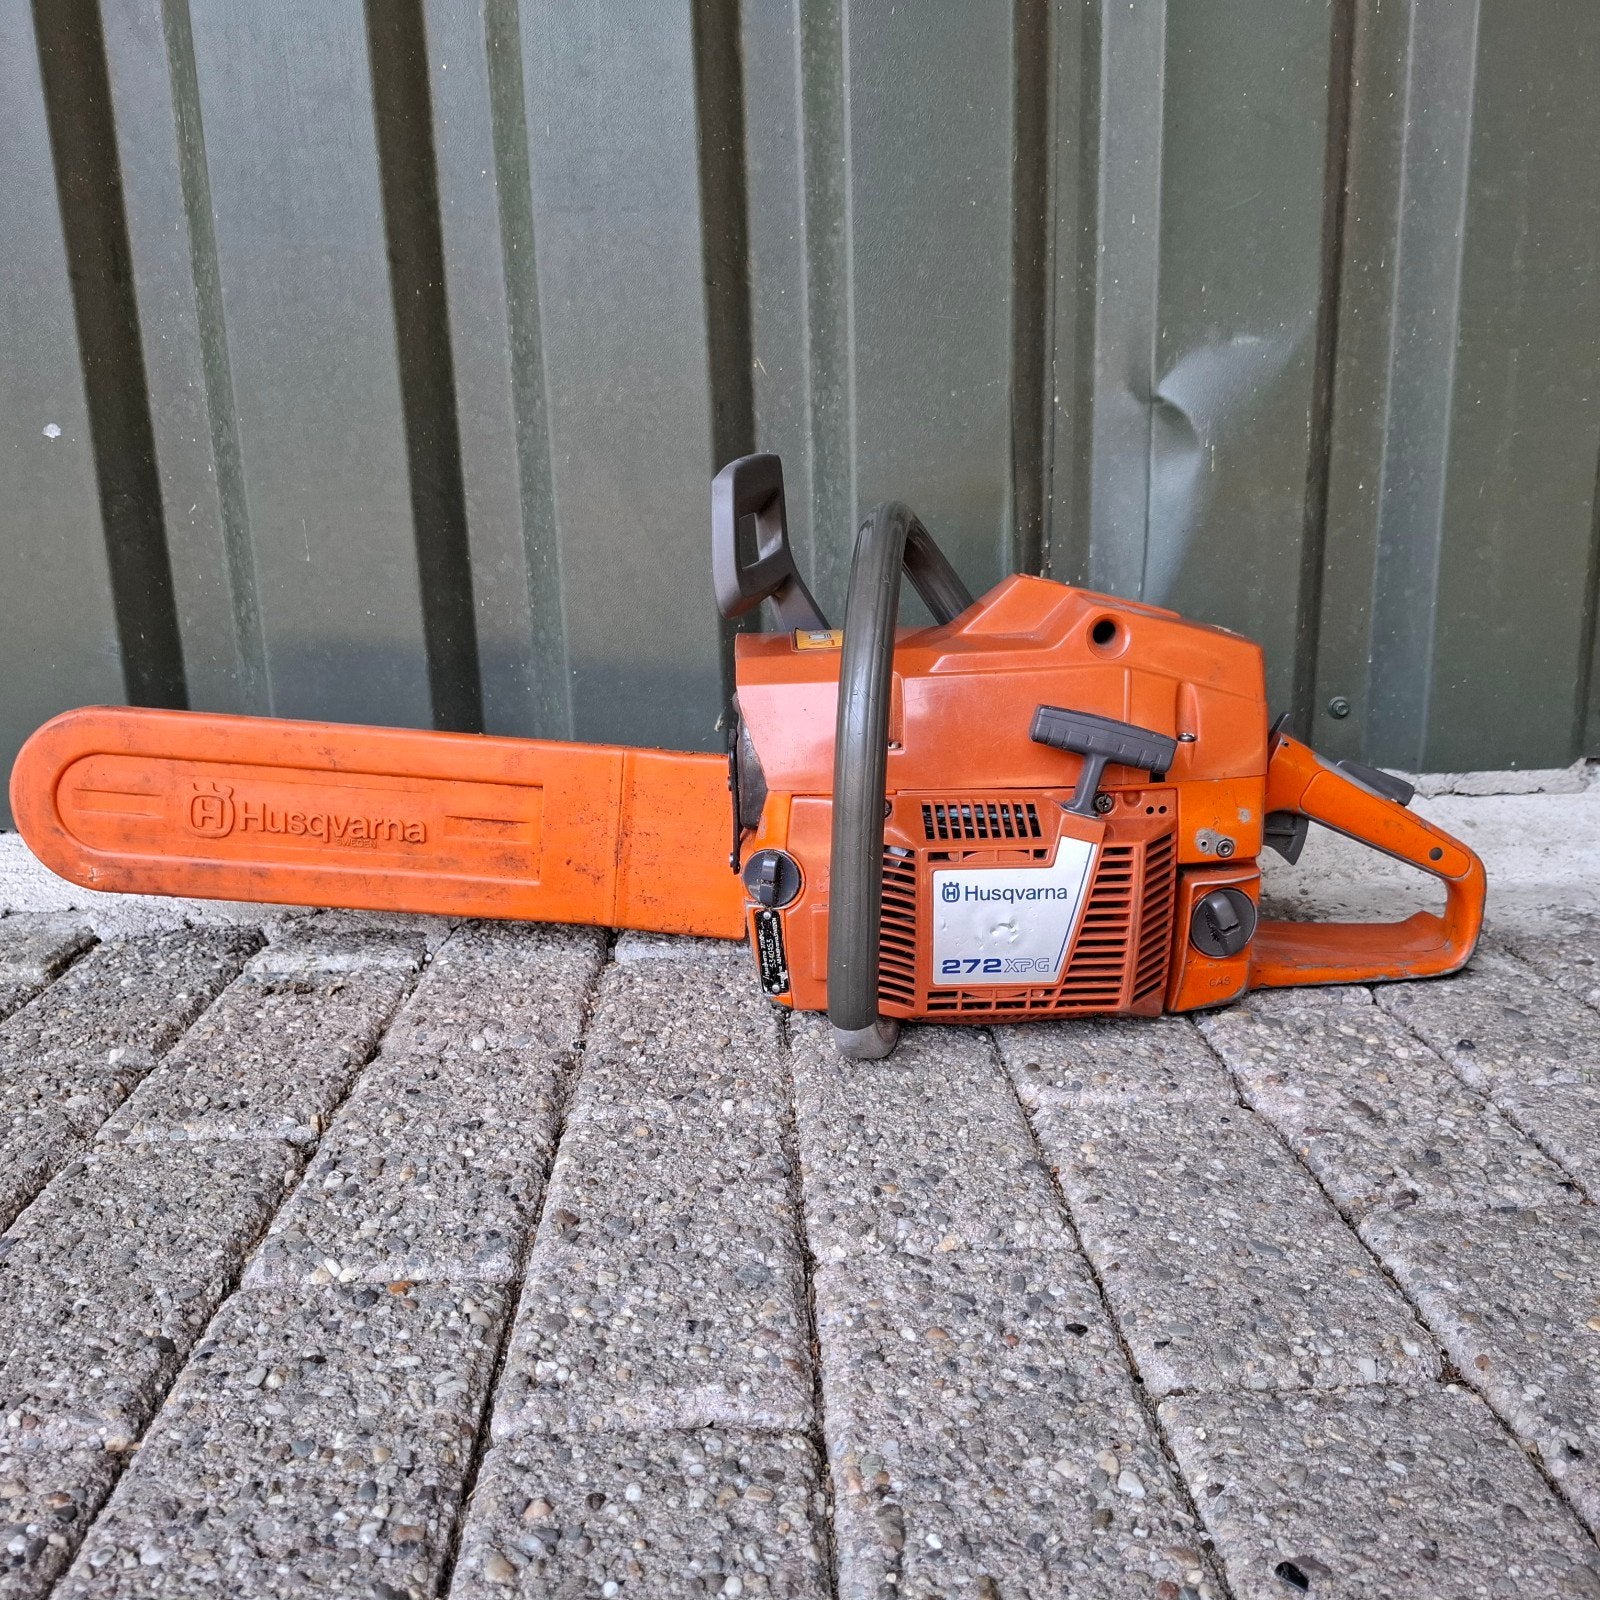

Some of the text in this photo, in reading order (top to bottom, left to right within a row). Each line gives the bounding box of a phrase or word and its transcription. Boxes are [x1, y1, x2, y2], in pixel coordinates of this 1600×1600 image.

[239, 801, 427, 844] Husqvarna
[334, 837, 378, 850] SWEDEN
[964, 885, 1068, 905] Husqvarna
